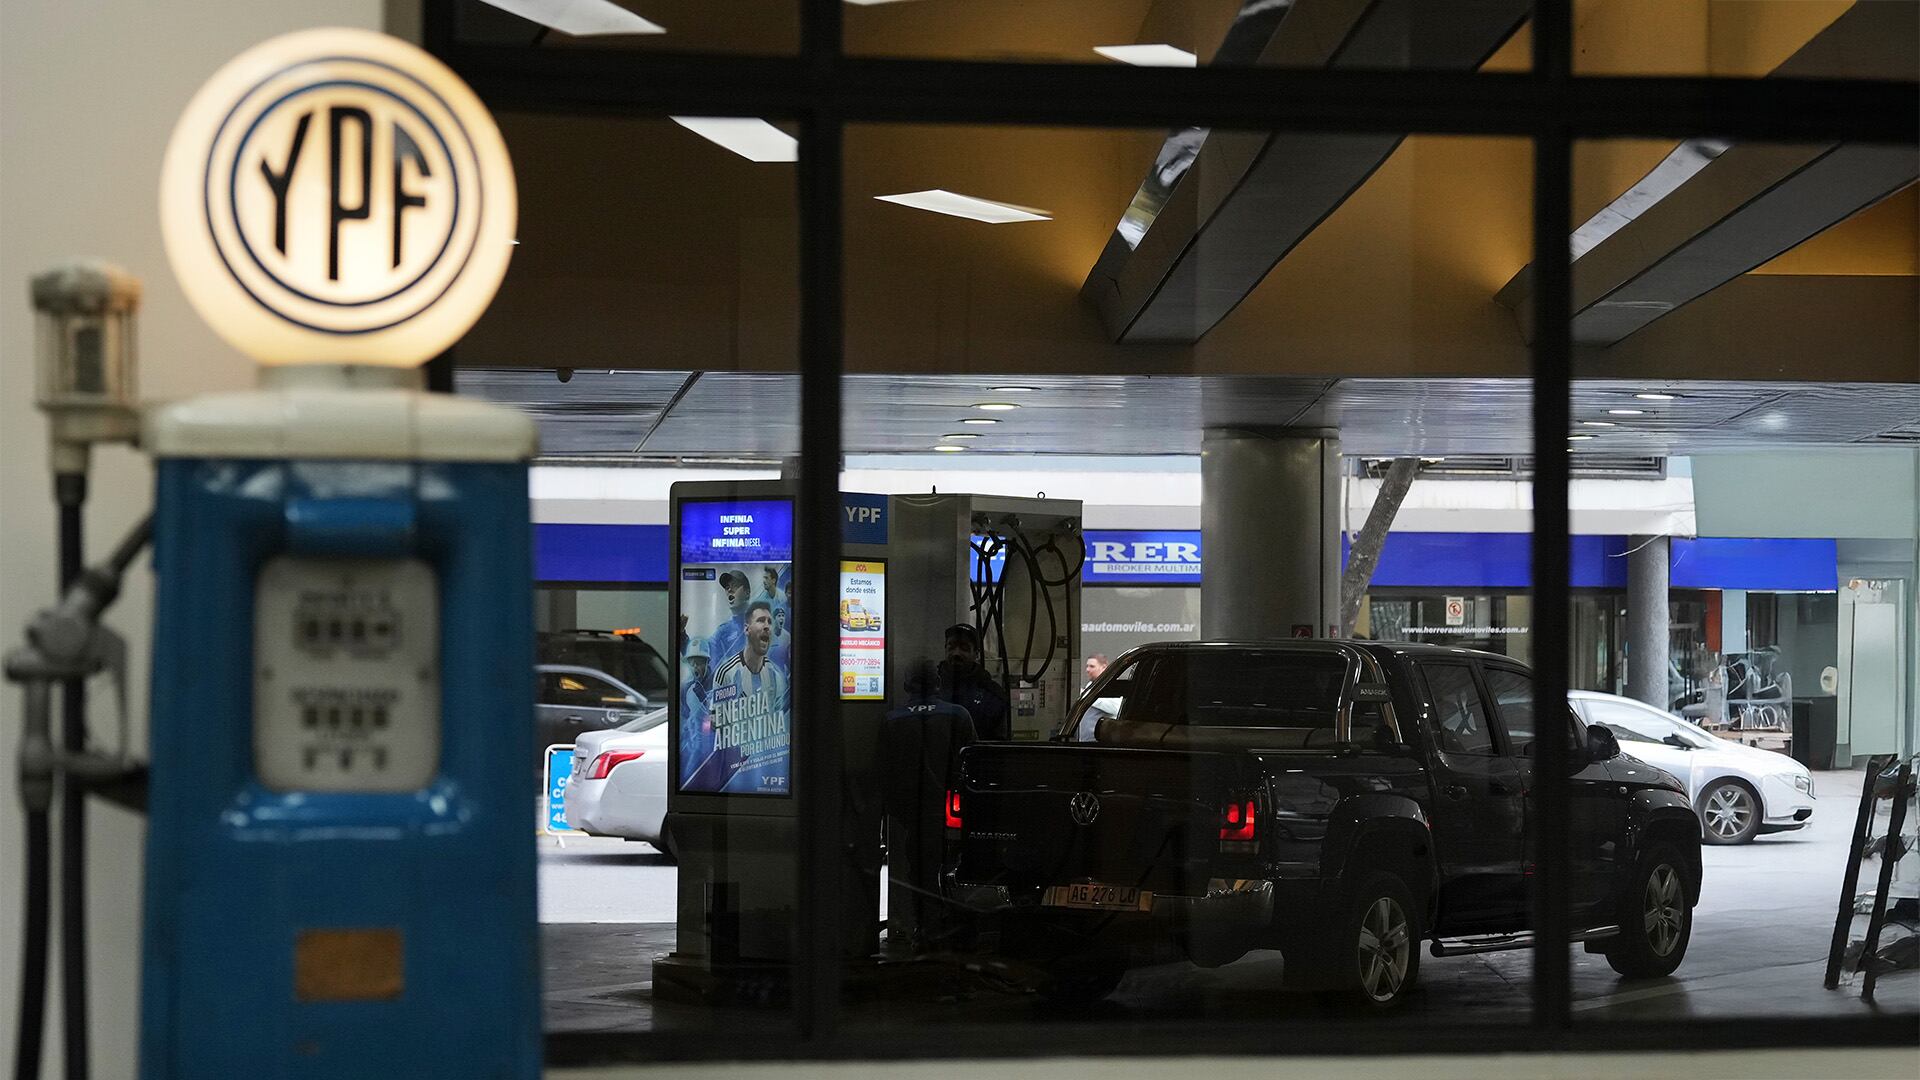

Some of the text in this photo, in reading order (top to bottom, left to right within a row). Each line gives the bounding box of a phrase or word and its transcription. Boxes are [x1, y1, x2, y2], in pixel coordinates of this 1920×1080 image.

[260, 106, 432, 281] YPF
[720, 515, 753, 524] INFINIA
[845, 506, 881, 523] YPF
[723, 527, 750, 535] SUPER
[1085, 542, 1201, 562] RER
[1107, 563, 1201, 572] BROKER MULTIM
[850, 578, 872, 586] Estamos
[715, 685, 737, 701] PROMO
[715, 687, 769, 727] ENERGÍA
[907, 704, 937, 713] YPF
[714, 710, 785, 751] ARGENTINA
[740, 733, 790, 757] POR EL MUNDO
[762, 776, 785, 785] YPF
[968, 831, 1017, 841] AMAROK
[1071, 886, 1088, 901] AG
